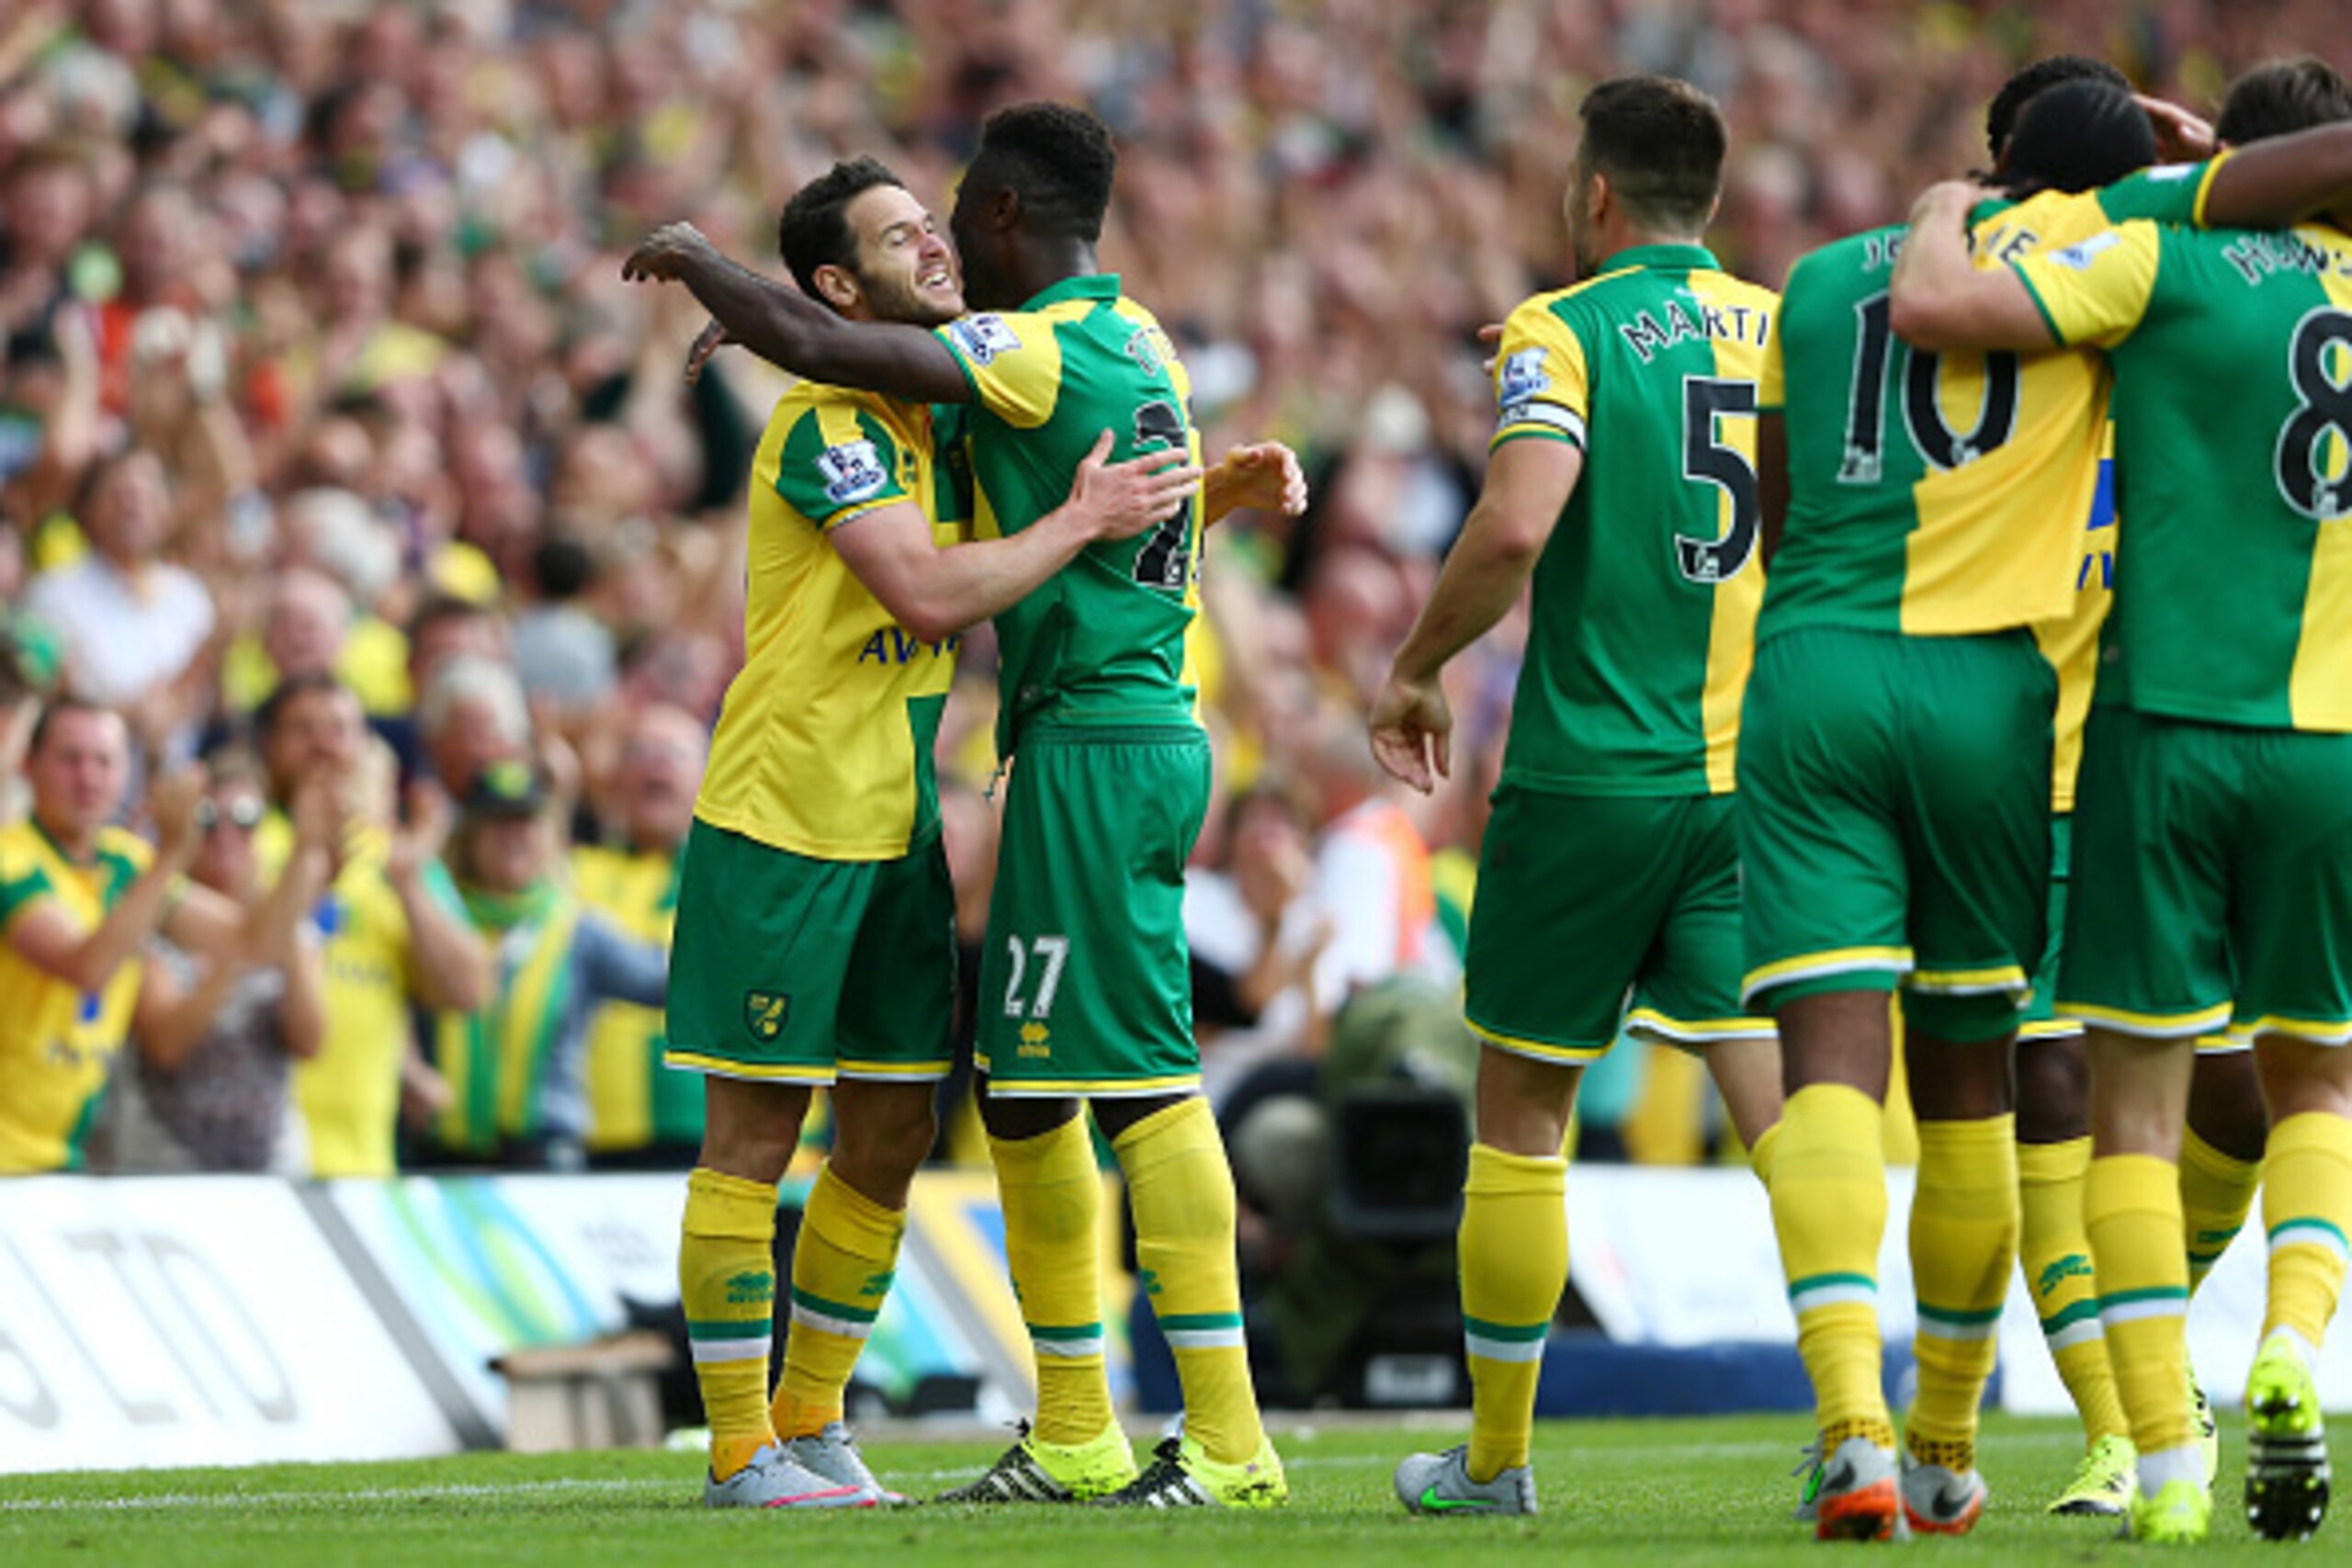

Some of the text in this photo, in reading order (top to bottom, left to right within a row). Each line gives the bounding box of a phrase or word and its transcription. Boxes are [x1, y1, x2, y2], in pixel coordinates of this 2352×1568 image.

[1675, 375, 1761, 583] 5
[1836, 288, 2022, 485] 10
[2273, 304, 2352, 521] 8
[1004, 933, 1070, 1019] 27
[3, 1229, 300, 1426] LTD
